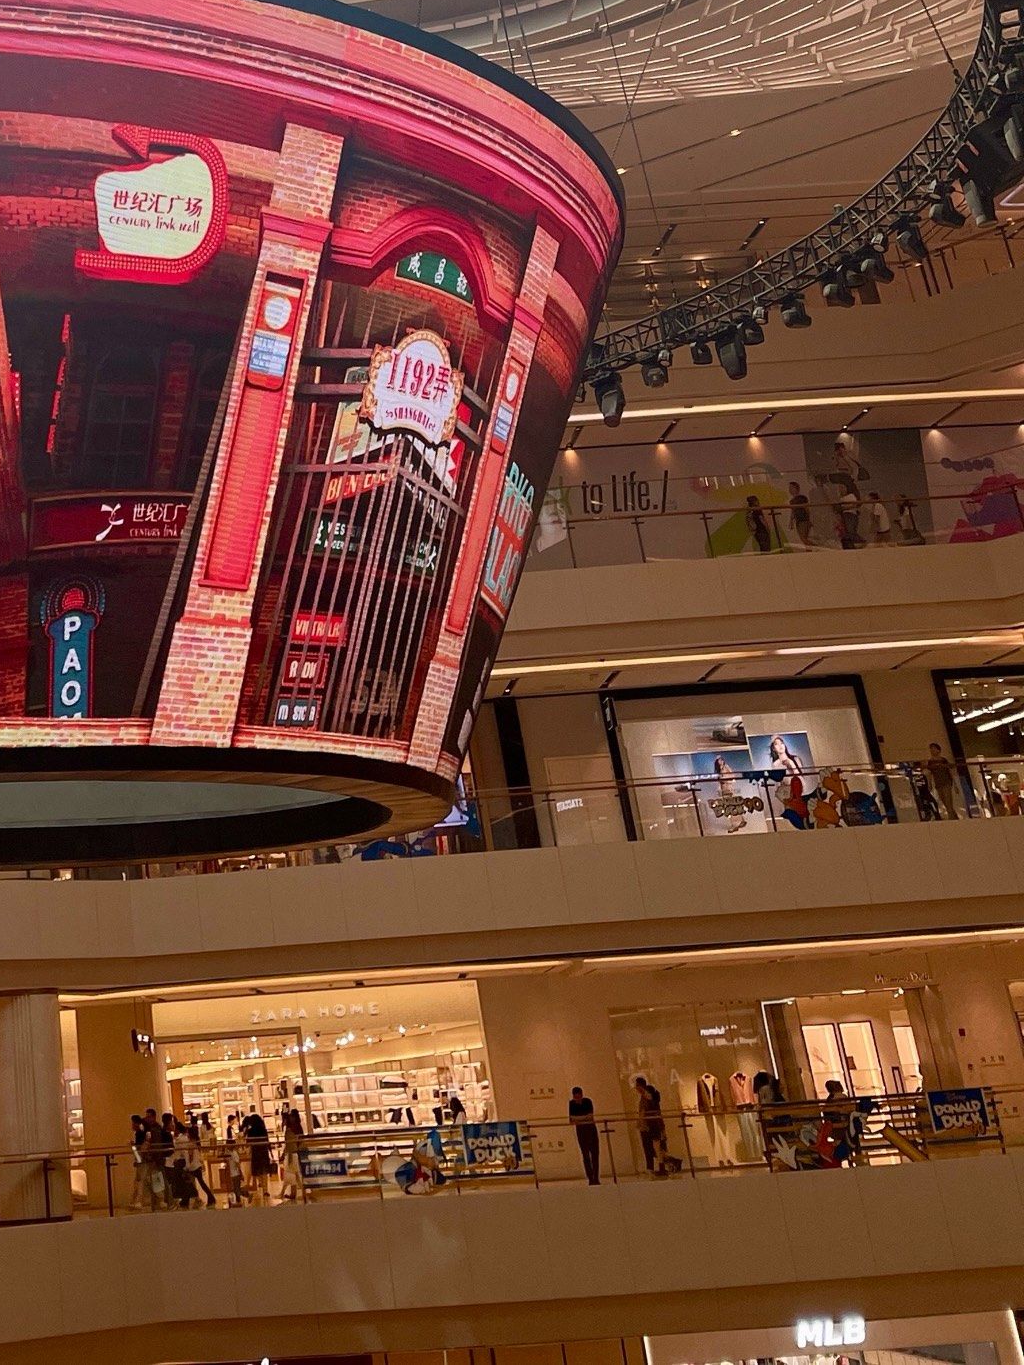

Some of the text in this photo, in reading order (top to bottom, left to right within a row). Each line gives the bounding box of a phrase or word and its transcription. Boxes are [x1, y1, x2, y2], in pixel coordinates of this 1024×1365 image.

[113, 189, 203, 218] 世纪汇广场
[109, 215, 151, 230] CENTURY
[155, 215, 175, 231] link
[386, 349, 452, 404] 1192弄
[581, 480, 603, 515] to
[133, 502, 190, 523] 世纪汇广
[60, 615, 82, 718] PAO
[249, 1001, 380, 1025] ZARA HOME
[933, 1099, 982, 1117] DONALD
[940, 1111, 984, 1130] DUCK
[467, 1133, 516, 1151] DONALD
[474, 1145, 517, 1164] DUCK
[796, 1315, 866, 1349] MLB
